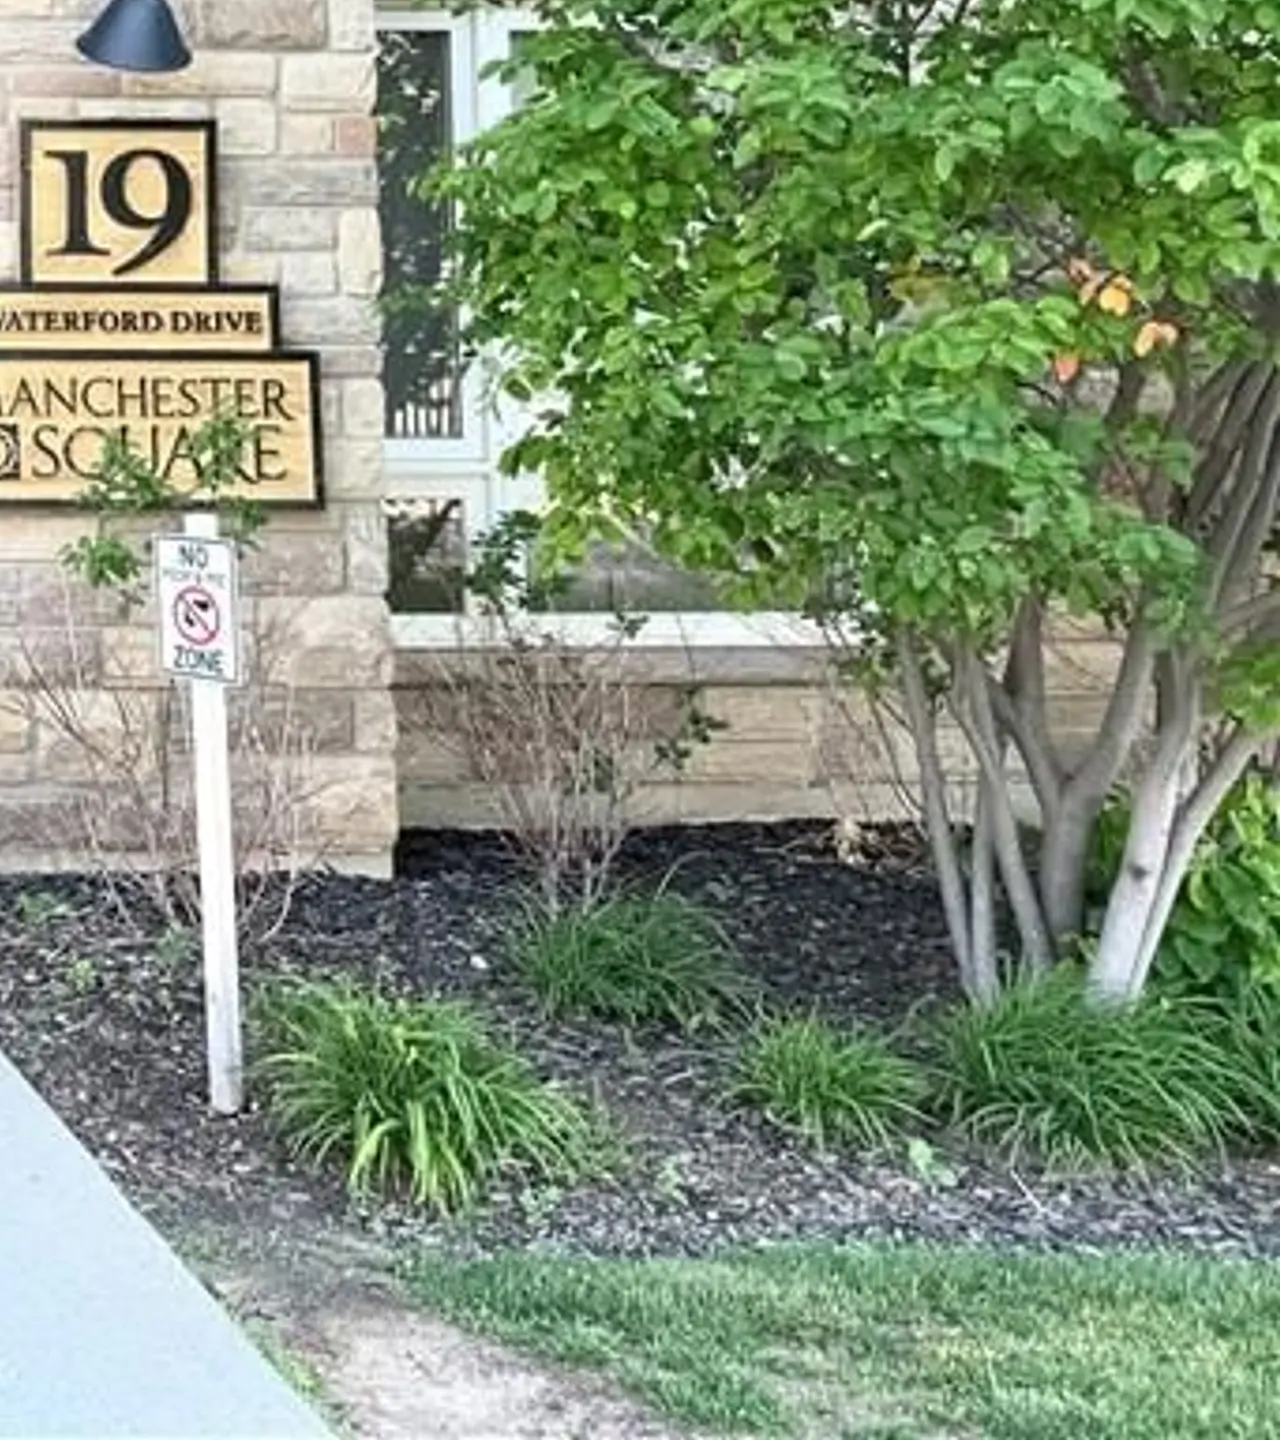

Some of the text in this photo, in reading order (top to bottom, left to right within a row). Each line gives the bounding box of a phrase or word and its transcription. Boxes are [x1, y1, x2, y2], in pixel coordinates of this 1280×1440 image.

[42, 148, 193, 276] 19
[170, 309, 262, 335] DRIVE
[30, 423, 289, 484] SQUAE
[178, 543, 209, 569] NO
[172, 644, 224, 676] ZONE
